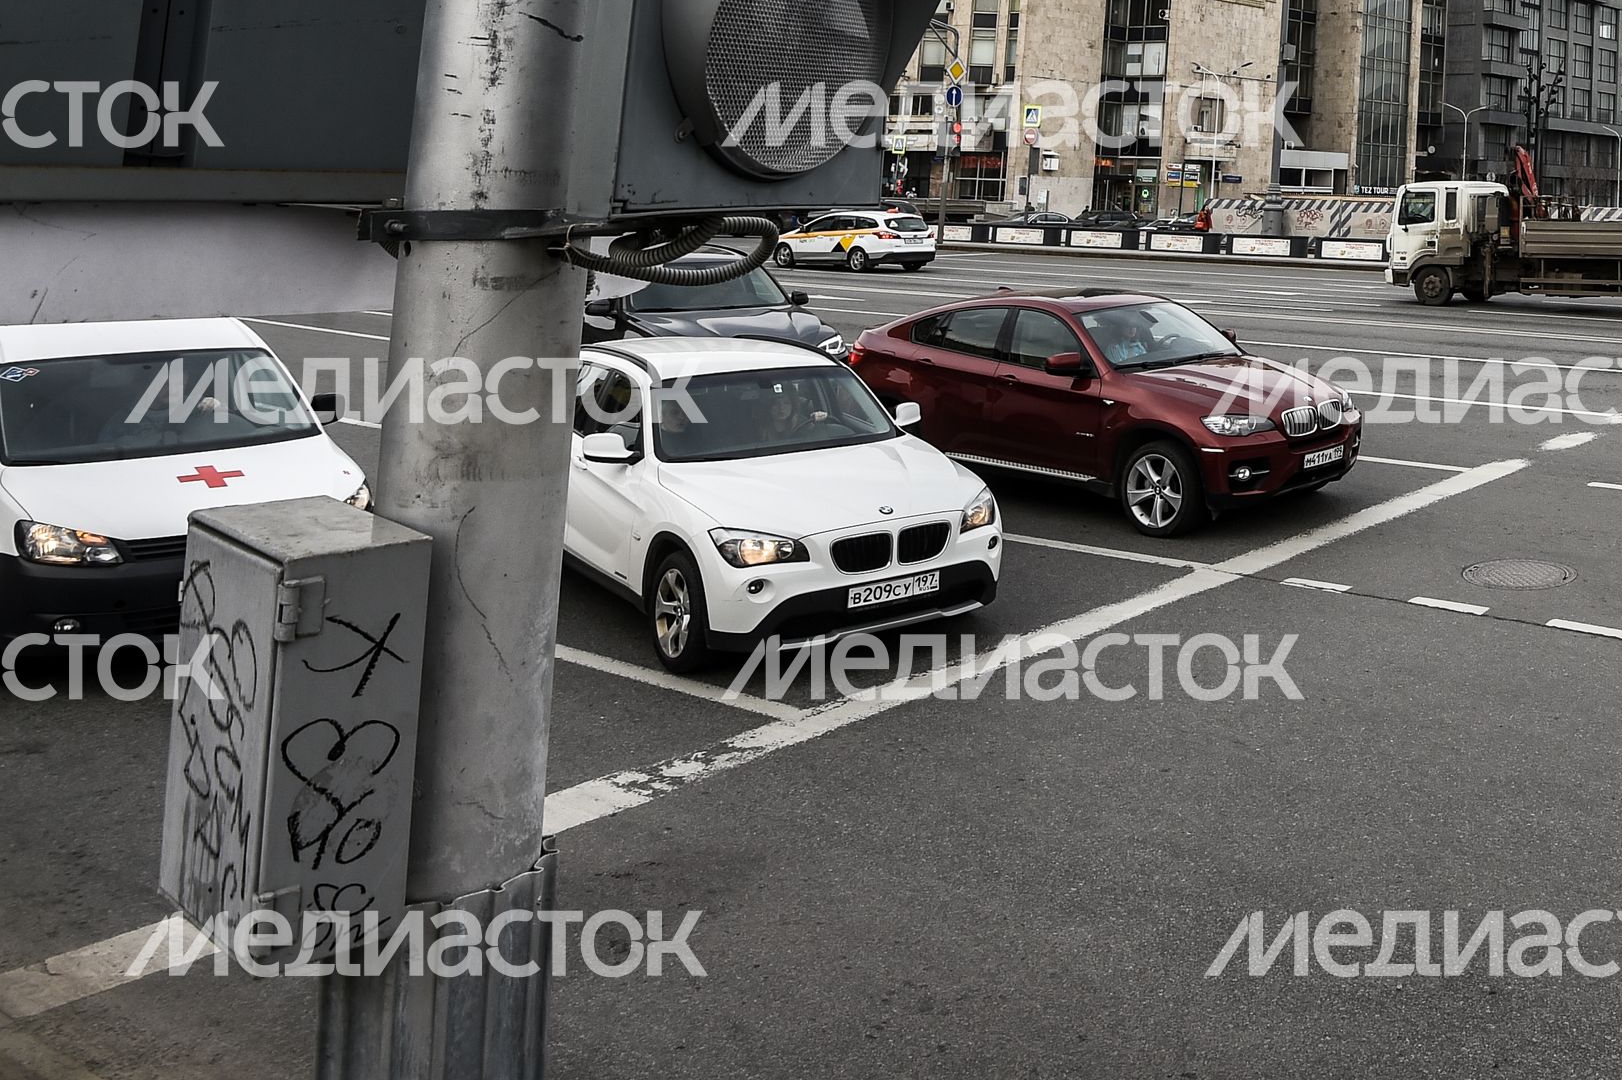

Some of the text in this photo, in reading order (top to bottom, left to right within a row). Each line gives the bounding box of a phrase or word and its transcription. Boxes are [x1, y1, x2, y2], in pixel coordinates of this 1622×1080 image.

[1361, 186, 1389, 195] TEZ TOUR
[852, 573, 935, 605] В209СУ 197
